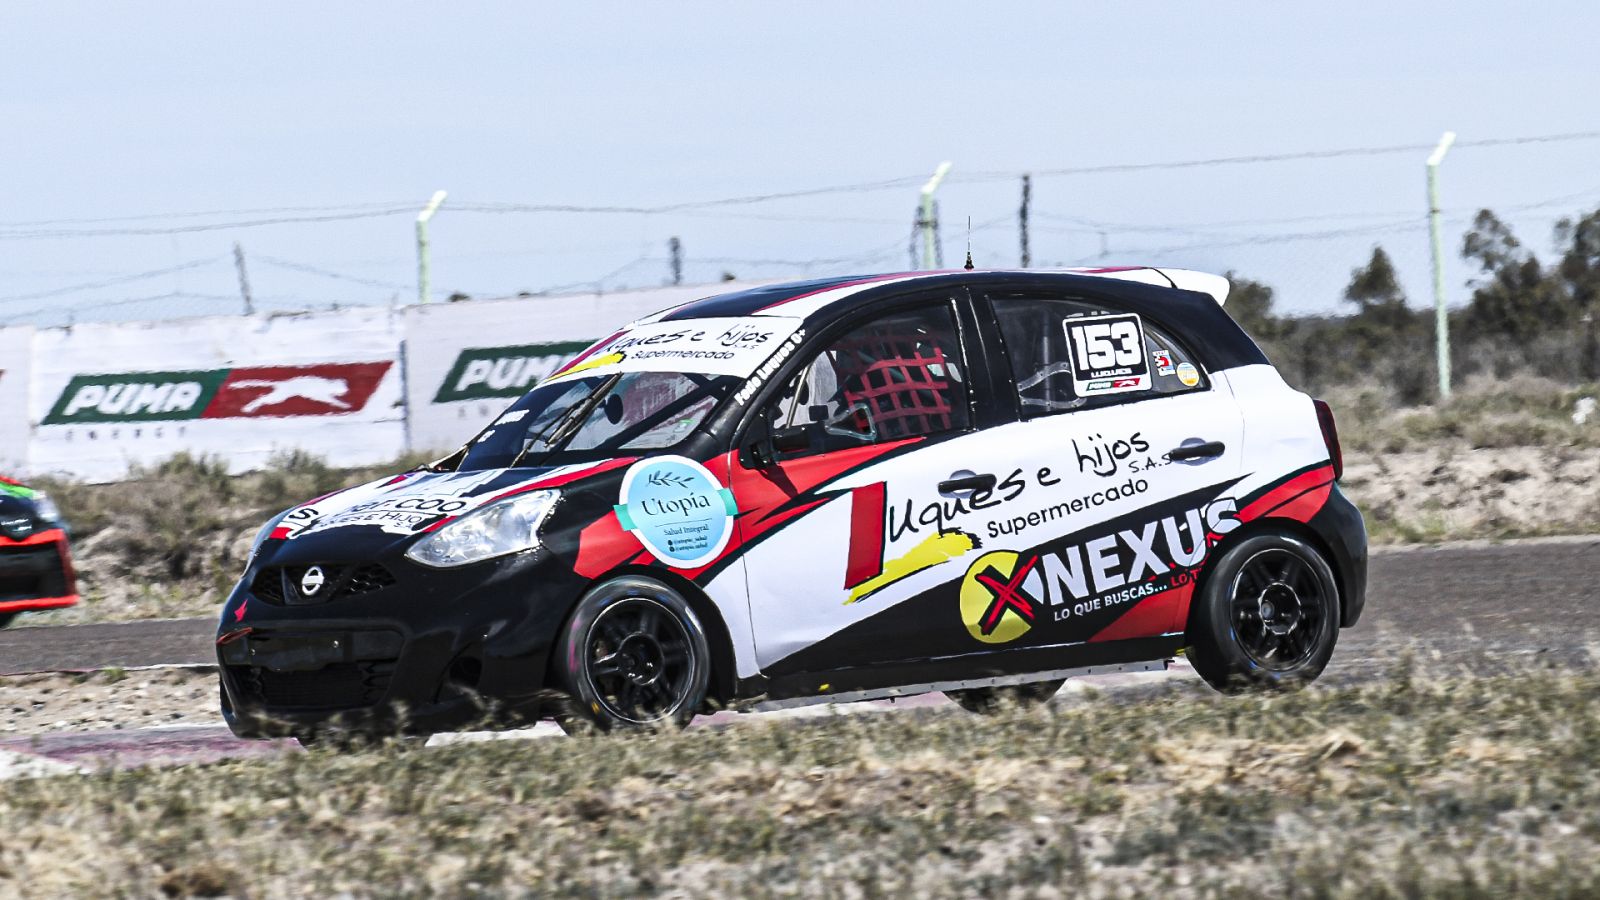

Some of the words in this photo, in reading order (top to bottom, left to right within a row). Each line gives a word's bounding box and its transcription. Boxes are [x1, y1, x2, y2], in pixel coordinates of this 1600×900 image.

[1071, 320, 1142, 371] 153
[453, 353, 577, 392] PUM
[63, 382, 203, 416] PUMA
[1037, 465, 1060, 487] e
[1072, 431, 1150, 477] hijos
[642, 491, 711, 517] Utopía
[986, 476, 1149, 539] Supermercado
[664, 527, 683, 536] Salud
[683, 524, 708, 534] Integral
[1041, 496, 1243, 606] NEXUS
[1053, 608, 1071, 622] LO
[1073, 598, 1102, 618] QUE
[1104, 583, 1168, 606] BUSCAS...
